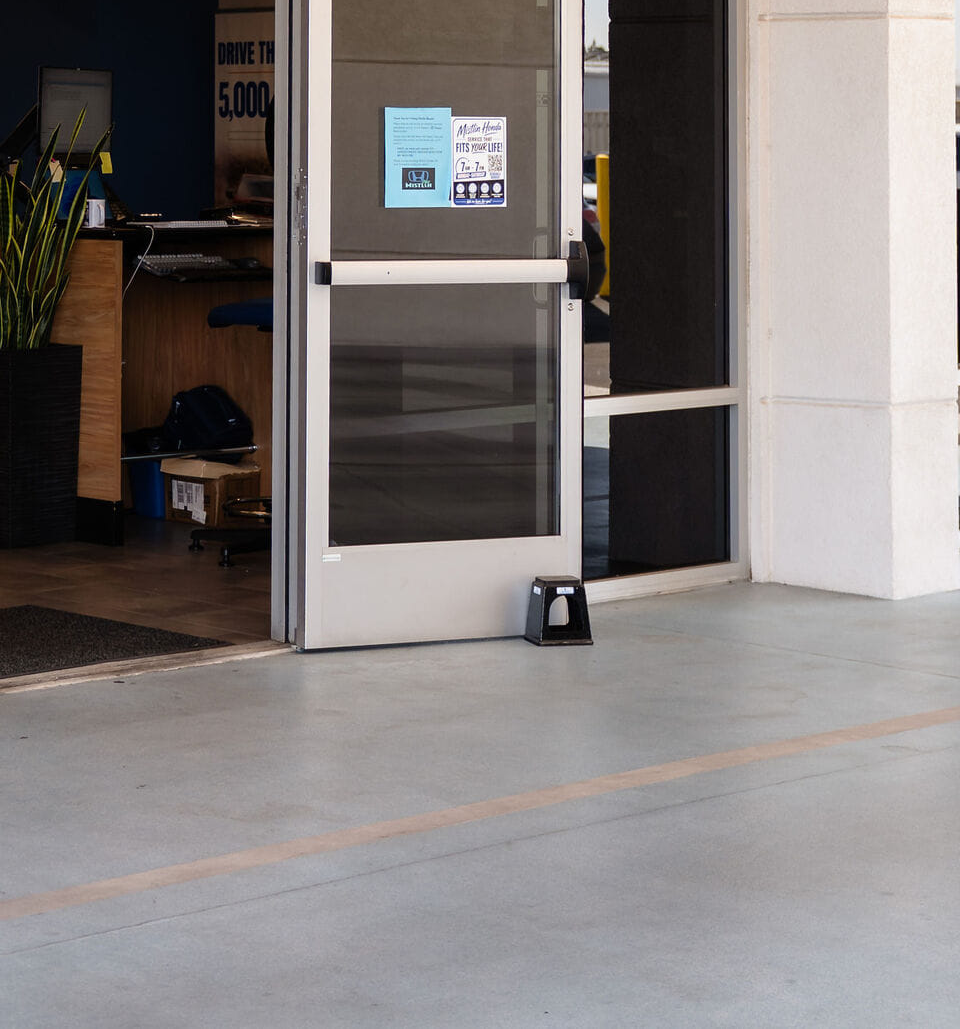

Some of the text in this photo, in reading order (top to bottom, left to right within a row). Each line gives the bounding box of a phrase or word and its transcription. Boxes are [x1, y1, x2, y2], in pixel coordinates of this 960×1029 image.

[218, 41, 255, 65] DRIVE
[218, 81, 270, 122] 5,000
[457, 123, 481, 138] Mistlin
[482, 121, 502, 135] Honda
[455, 142, 470, 153] FITS
[470, 142, 487, 153] YOUR
[488, 142, 503, 153] LIFE!
